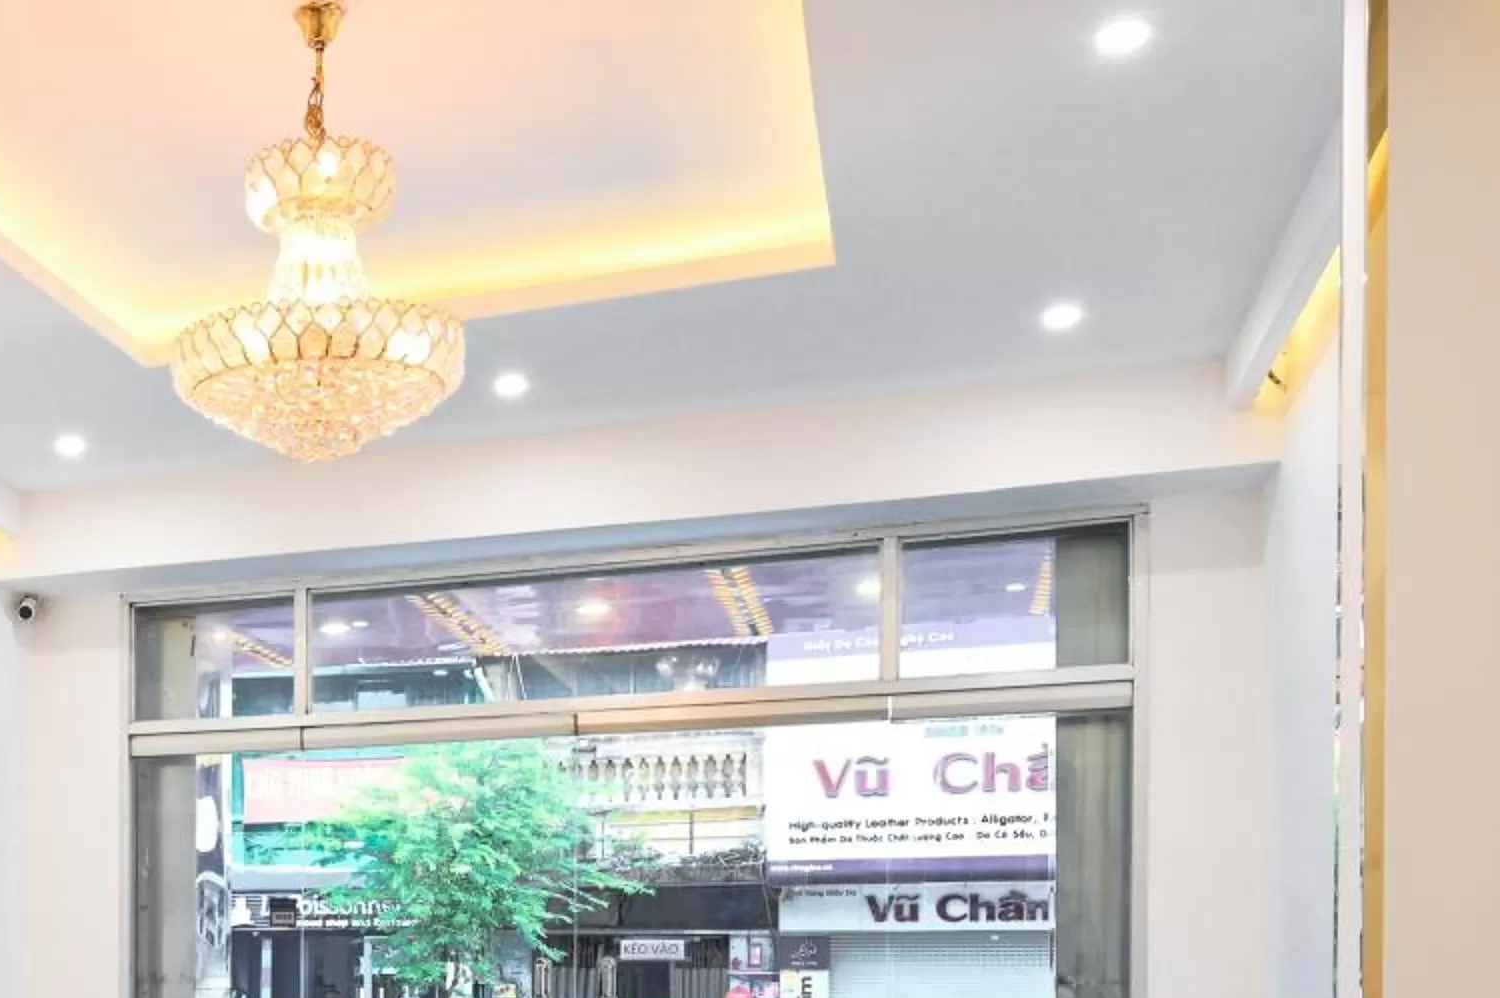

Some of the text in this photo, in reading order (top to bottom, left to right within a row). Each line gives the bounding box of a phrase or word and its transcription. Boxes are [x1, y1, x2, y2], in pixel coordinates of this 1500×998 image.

[812, 755, 890, 799] Vũ
[865, 819, 909, 829] Leather
[914, 816, 969, 827] Products
[865, 893, 921, 923] Vũ
